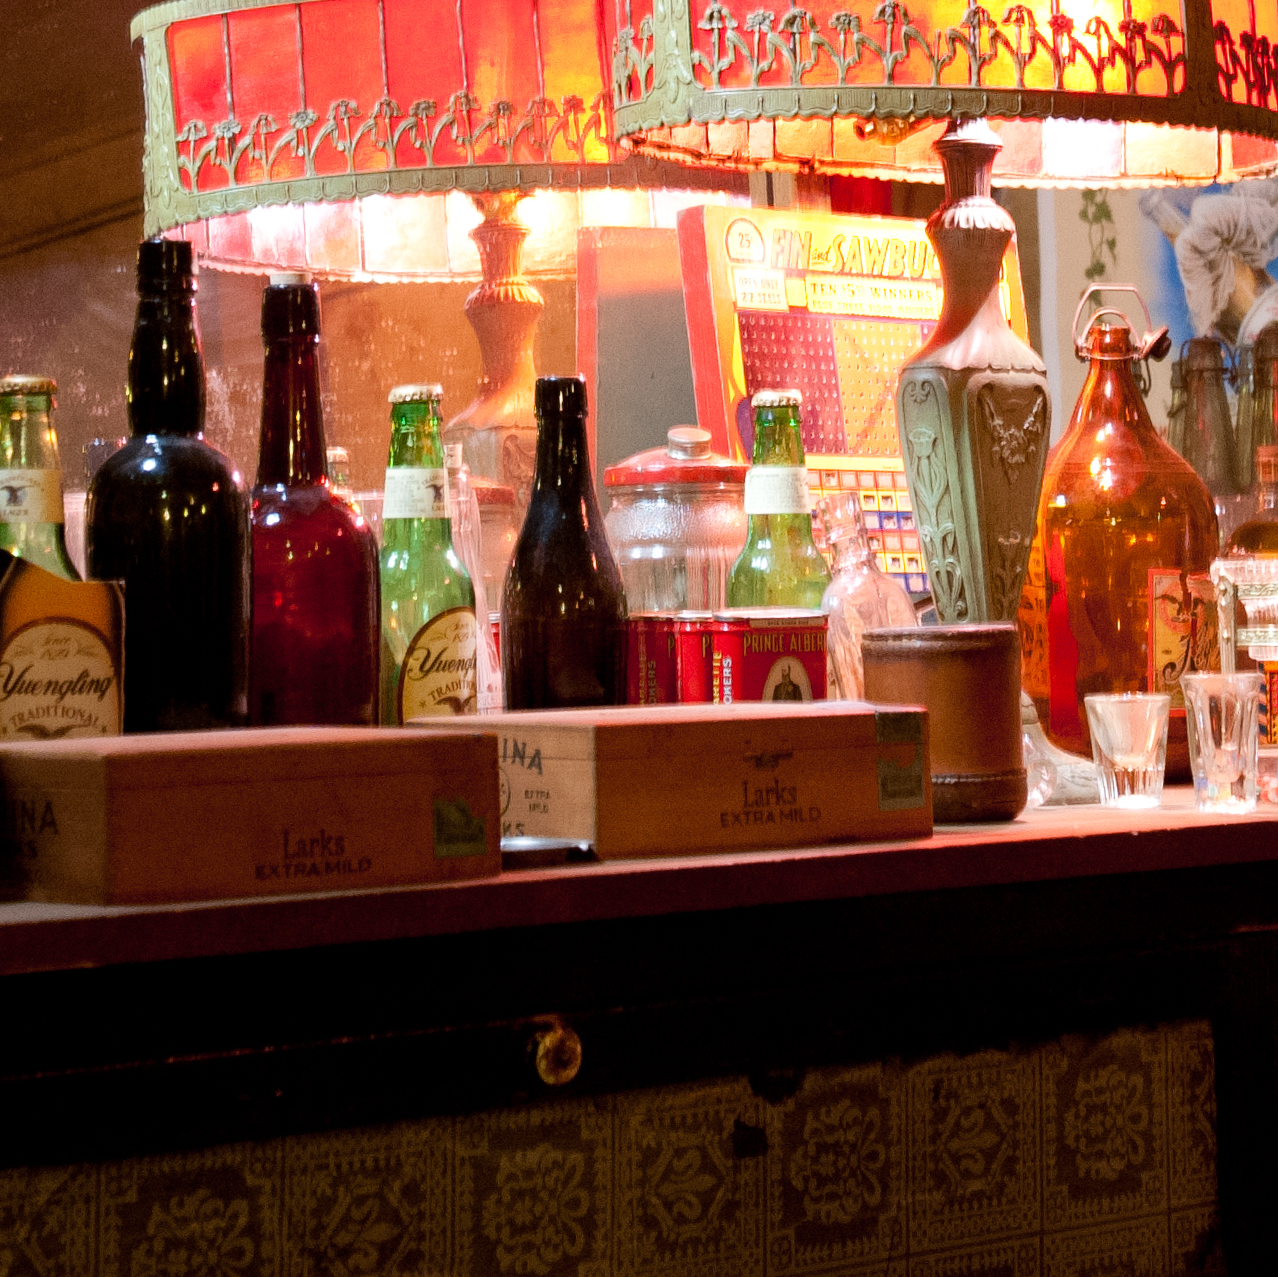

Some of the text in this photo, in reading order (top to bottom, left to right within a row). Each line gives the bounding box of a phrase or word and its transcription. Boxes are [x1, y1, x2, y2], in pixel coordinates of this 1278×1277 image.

[771, 228, 940, 278] FIN and SAWBUC
[810, 282, 837, 296] TEN
[869, 286, 933, 303] WINNERS
[812, 301, 833, 310] PLUS
[837, 302, 864, 312] THREE
[896, 304, 935, 315] WINNERS
[743, 631, 827, 657] PRINCE ALBER
[712, 651, 722, 705] ARETTE
[723, 658, 732, 705] OKERS
[9, 705, 100, 727] TRADITIONAL
[743, 777, 798, 808] Larks
[720, 807, 821, 828] EXTRA MILD
[282, 828, 346, 860] Larks
[254, 857, 372, 880] EXTRA MILD
